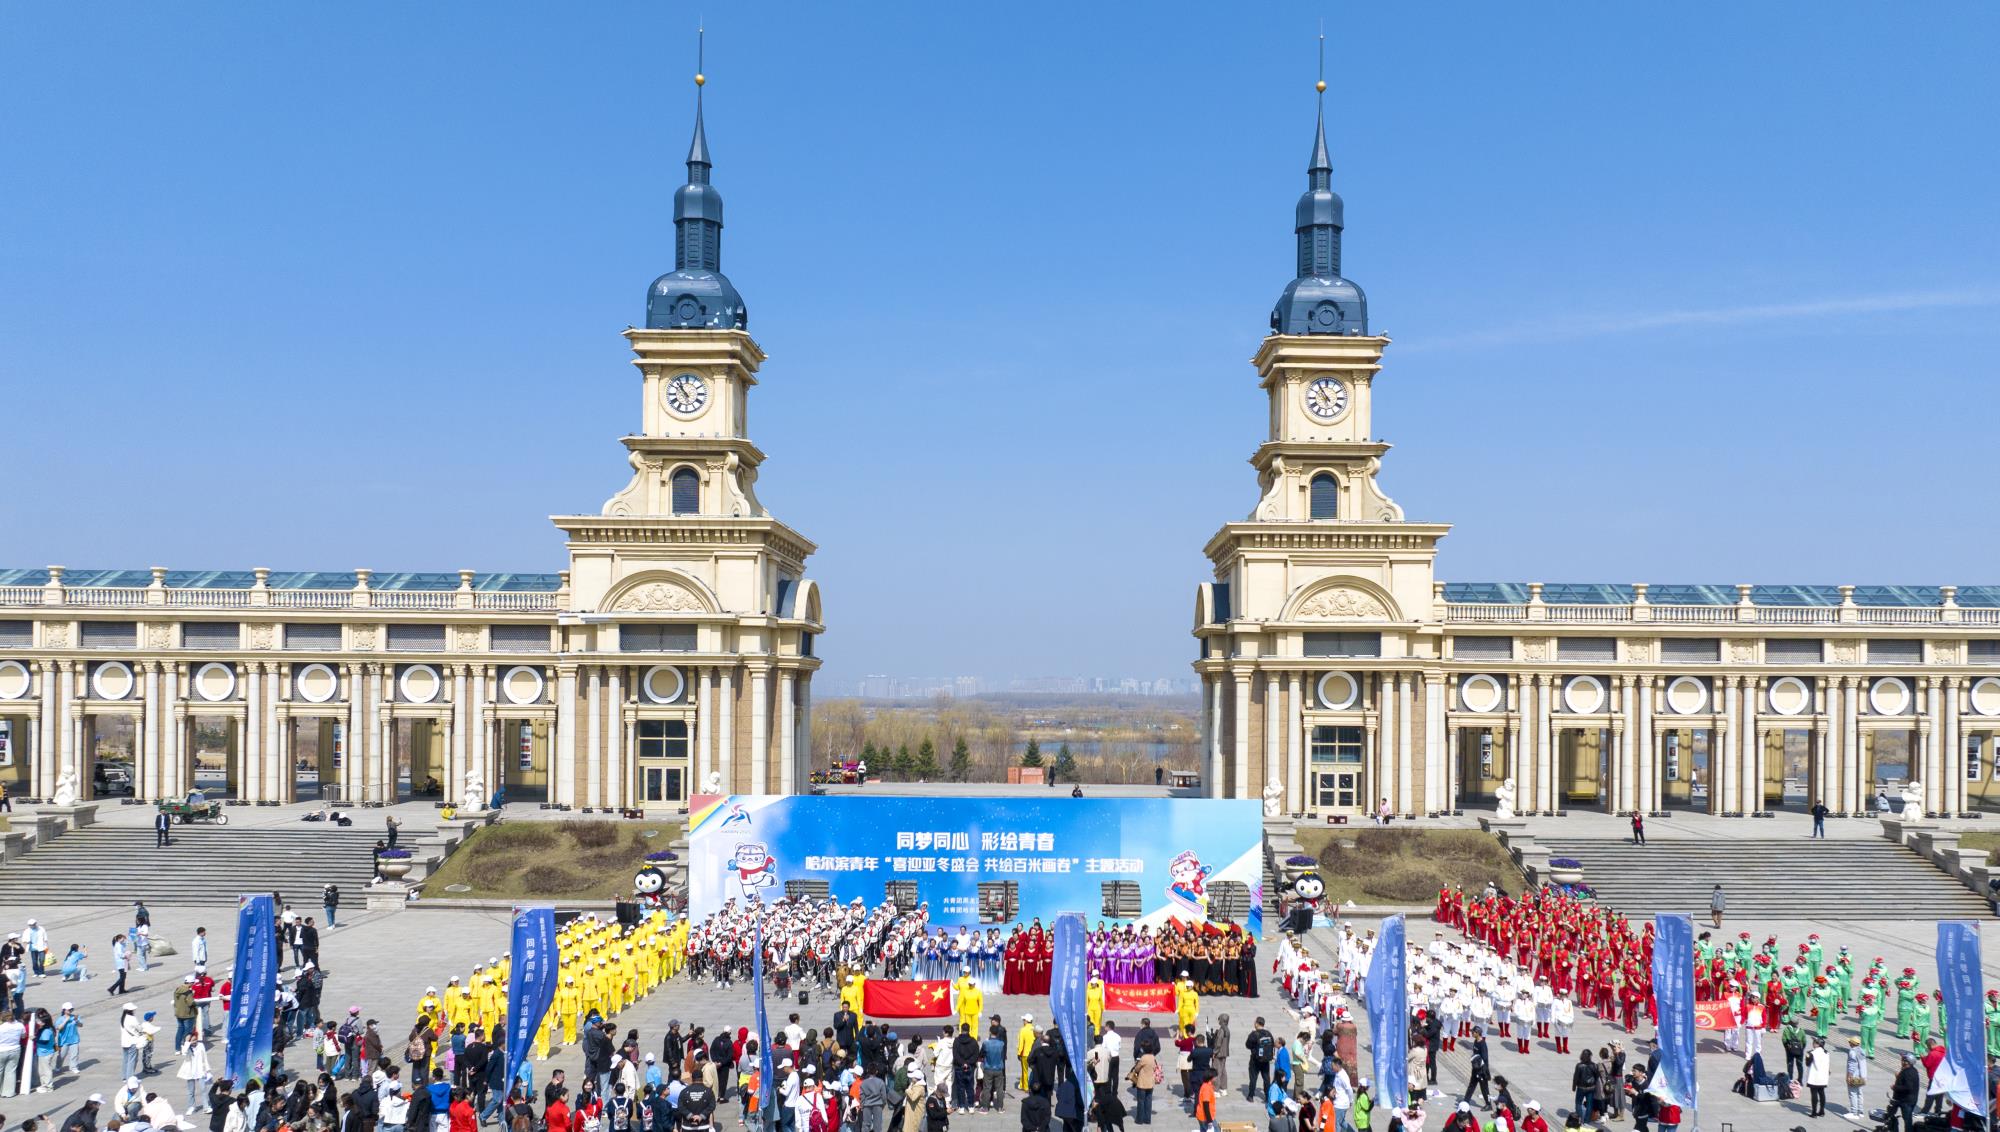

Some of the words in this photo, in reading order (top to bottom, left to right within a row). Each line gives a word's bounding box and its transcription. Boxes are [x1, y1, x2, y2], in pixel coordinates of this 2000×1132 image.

[896, 832, 970, 851] 同梦同心
[981, 832, 1055, 851] 彩绘青春
[525, 938, 536, 983] 同梦同心
[518, 995, 531, 1040] 彩绘青春
